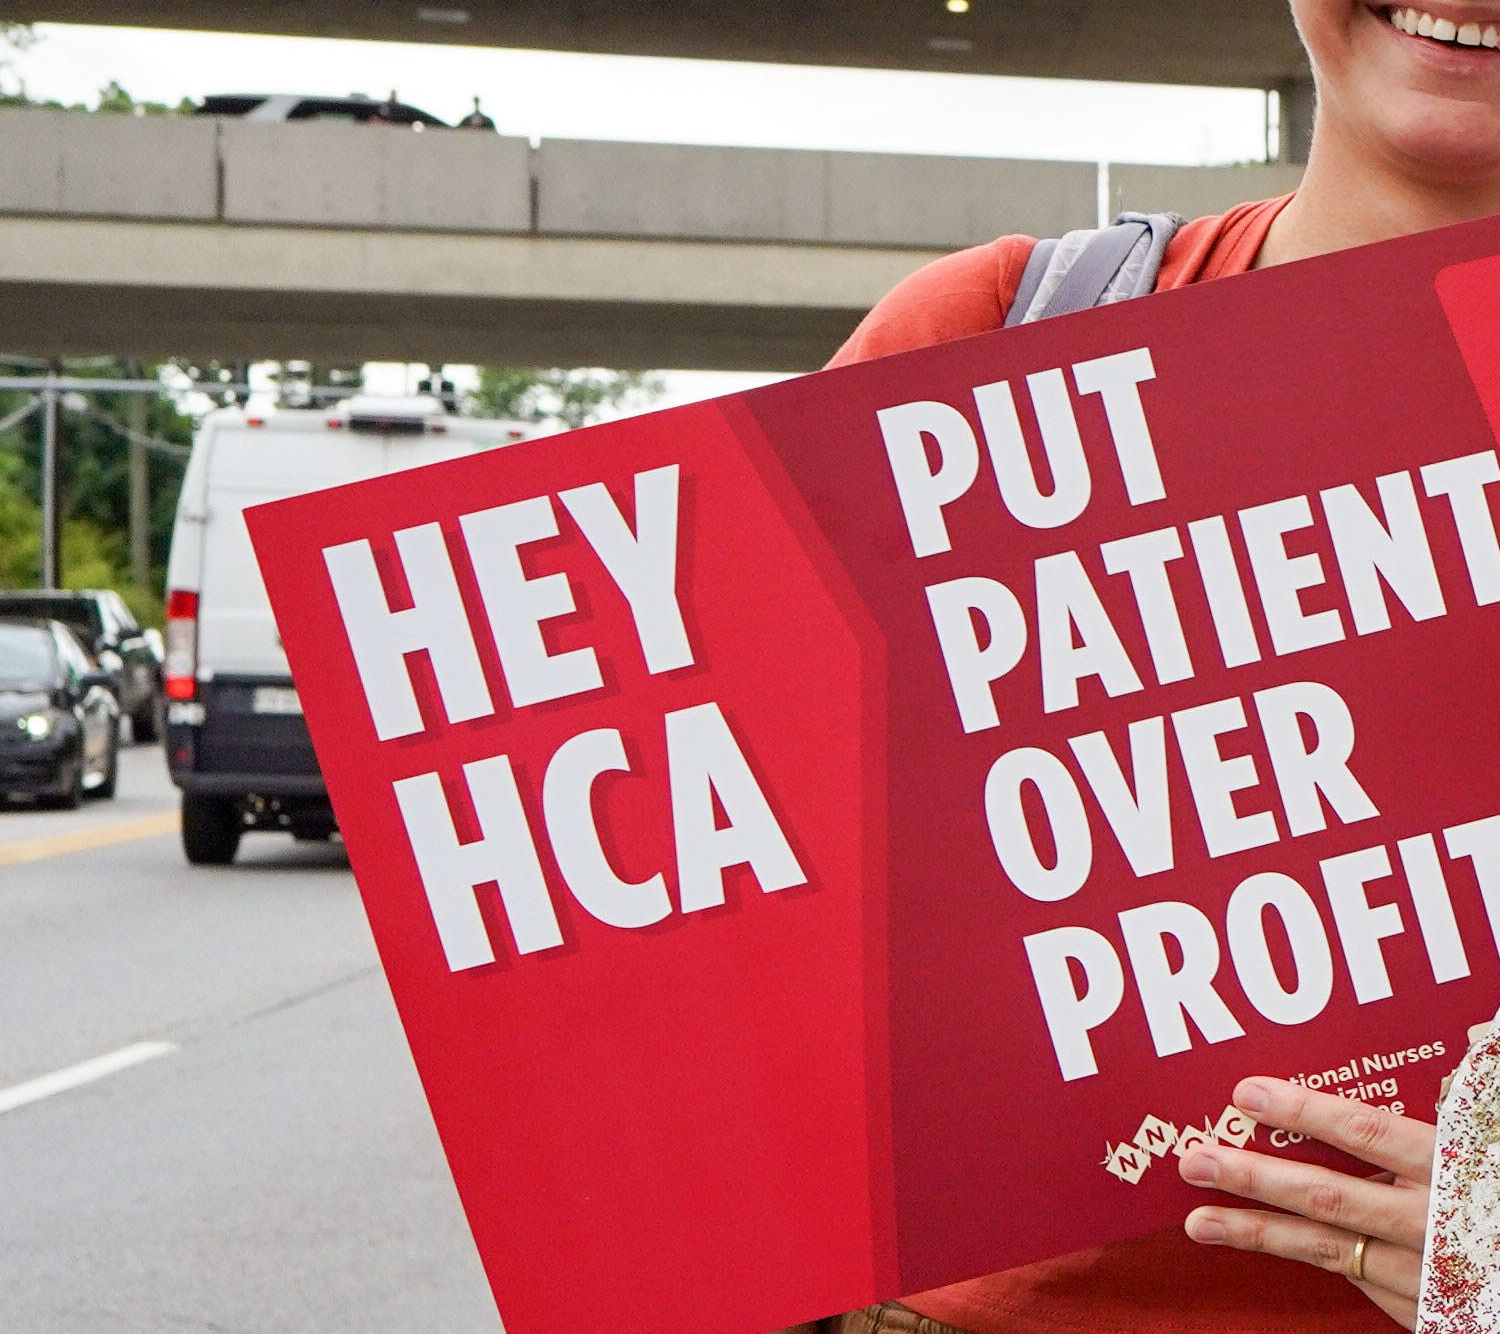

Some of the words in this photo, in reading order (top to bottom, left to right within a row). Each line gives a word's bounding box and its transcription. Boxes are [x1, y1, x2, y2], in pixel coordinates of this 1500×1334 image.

[877, 348, 1166, 557] PUT
[323, 464, 694, 741] HEY
[393, 702, 807, 972] HCA
[985, 682, 1380, 901] OVER
[1291, 1060, 1359, 1090] tional
[1362, 1042, 1445, 1074] Nurses
